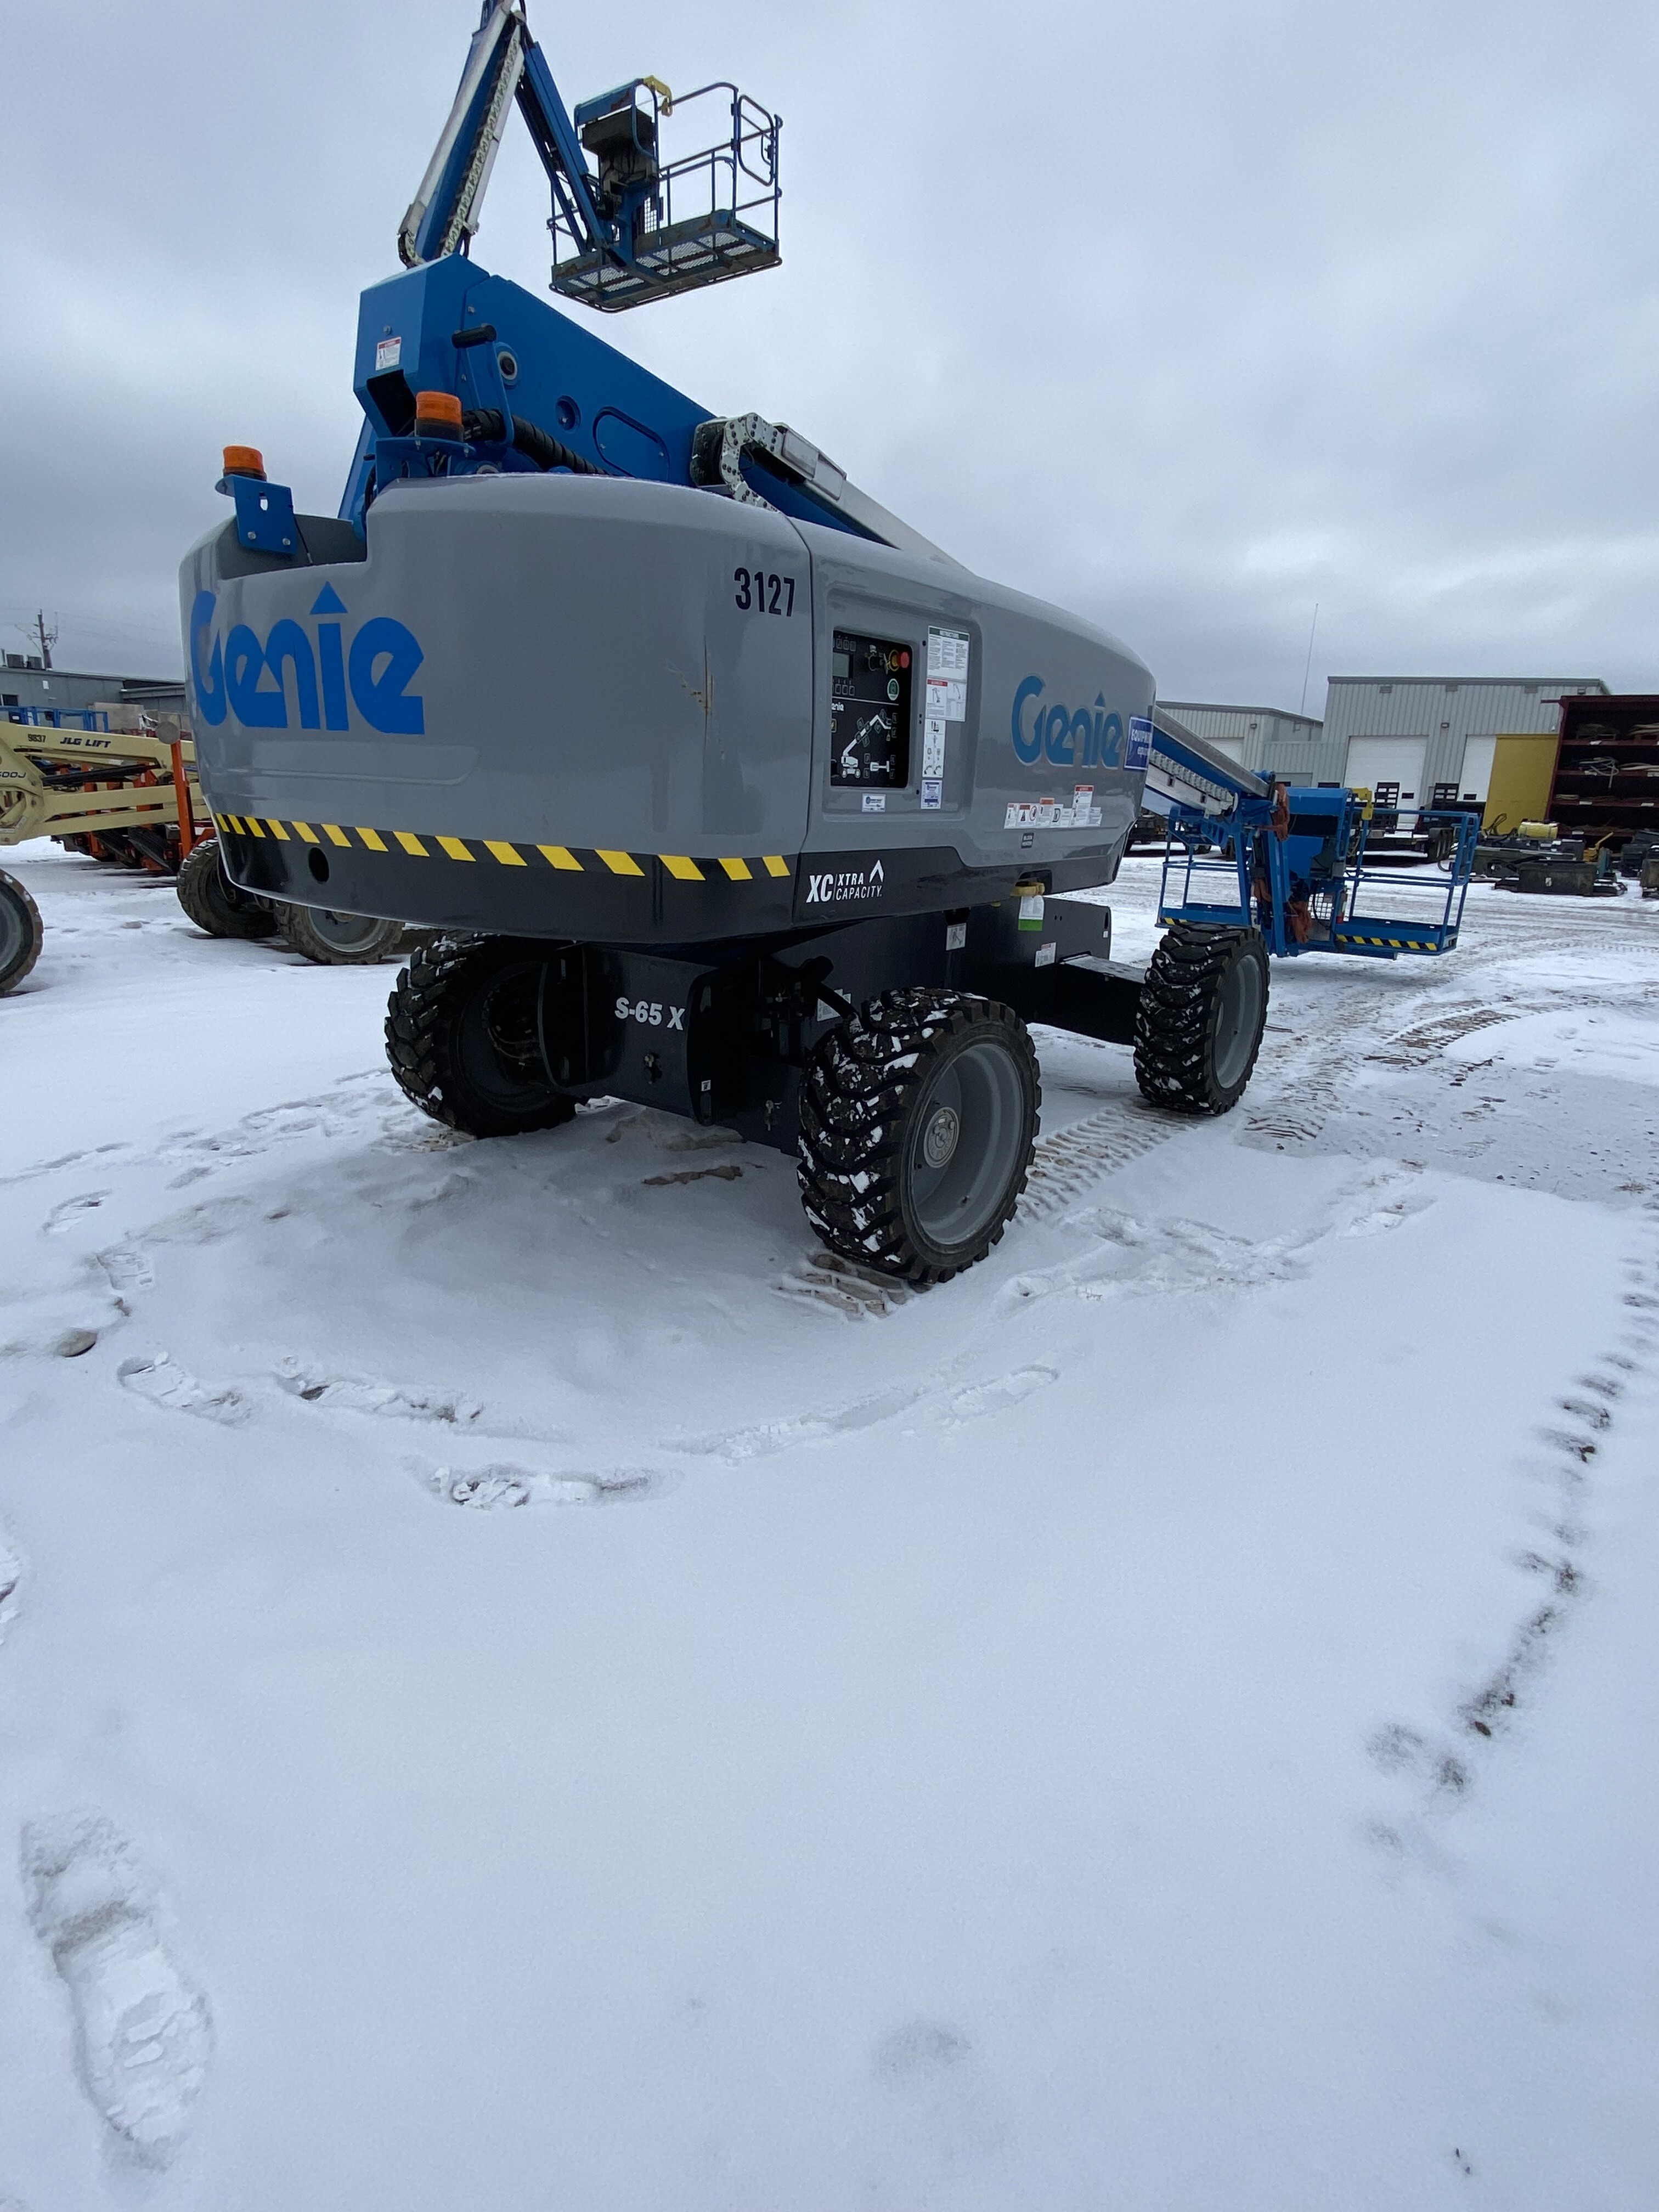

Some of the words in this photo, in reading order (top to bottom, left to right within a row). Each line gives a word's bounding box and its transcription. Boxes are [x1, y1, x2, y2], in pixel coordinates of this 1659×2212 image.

[734, 567, 795, 617] 3127
[190, 582, 425, 735] Genie
[1012, 675, 1124, 769] Genie
[60, 737, 82, 746] JLG
[86, 739, 111, 748] LIFT
[806, 874, 834, 902] XC
[837, 873, 864, 886] XTRA
[836, 885, 883, 901] CAPACITY
[614, 997, 663, 1025] S-65
[667, 1006, 685, 1030] X
